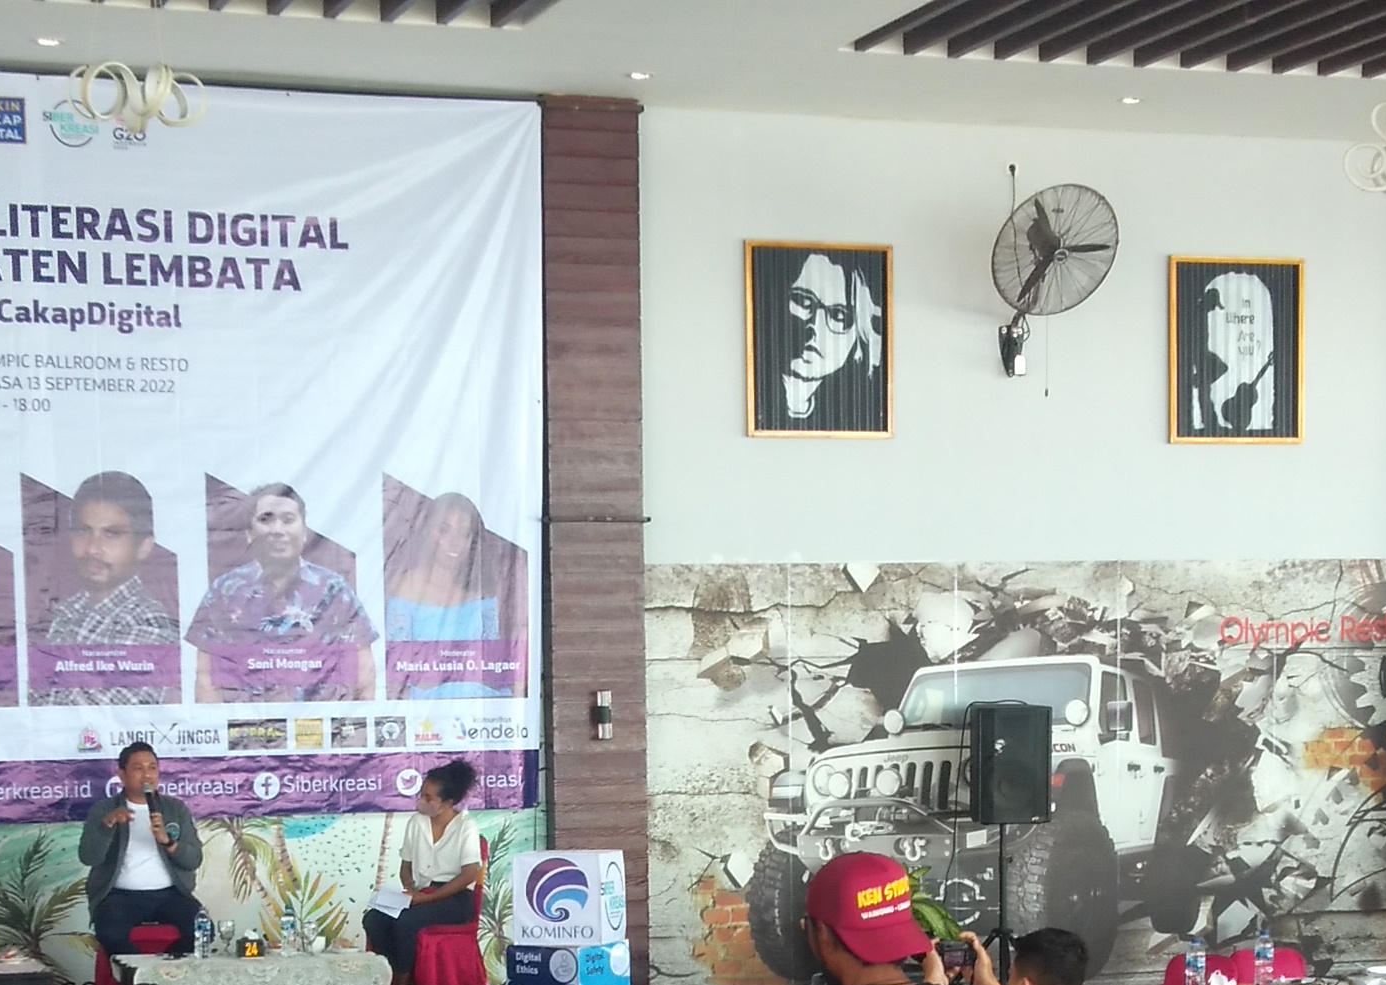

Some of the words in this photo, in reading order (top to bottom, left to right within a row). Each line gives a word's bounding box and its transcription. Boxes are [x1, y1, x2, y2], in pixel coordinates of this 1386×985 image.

[60, 124, 99, 135] KREASI
[186, 210, 350, 250] DIGITAL
[101, 250, 302, 292] LEMBATA
[35, 354, 122, 370] BALLROOM
[126, 357, 136, 371] &
[140, 357, 189, 372] RESTO
[27, 376, 41, 390] 13
[45, 377, 136, 392] SEPTEMBER
[139, 380, 176, 393] 2022
[13, 398, 51, 412] 18.00
[1219, 616, 1332, 650] Olympic
[55, 660, 94, 671] Alfred
[96, 660, 115, 671] Ike
[116, 660, 154, 671] Wurin
[248, 658, 274, 669] Soni
[276, 658, 323, 672] Mongan
[396, 660, 430, 671] Maria
[433, 660, 463, 671] Lusia
[466, 660, 479, 671] O.
[110, 730, 155, 745] LANGIT
[175, 729, 221, 745] JINGGA
[883, 753, 909, 764] Jeep
[283, 773, 383, 793] Siberkreasi
[521, 925, 594, 939] KOMINFO
[244, 941, 259, 957] 24
[515, 951, 542, 963] Digital
[516, 965, 539, 976] Ethics
